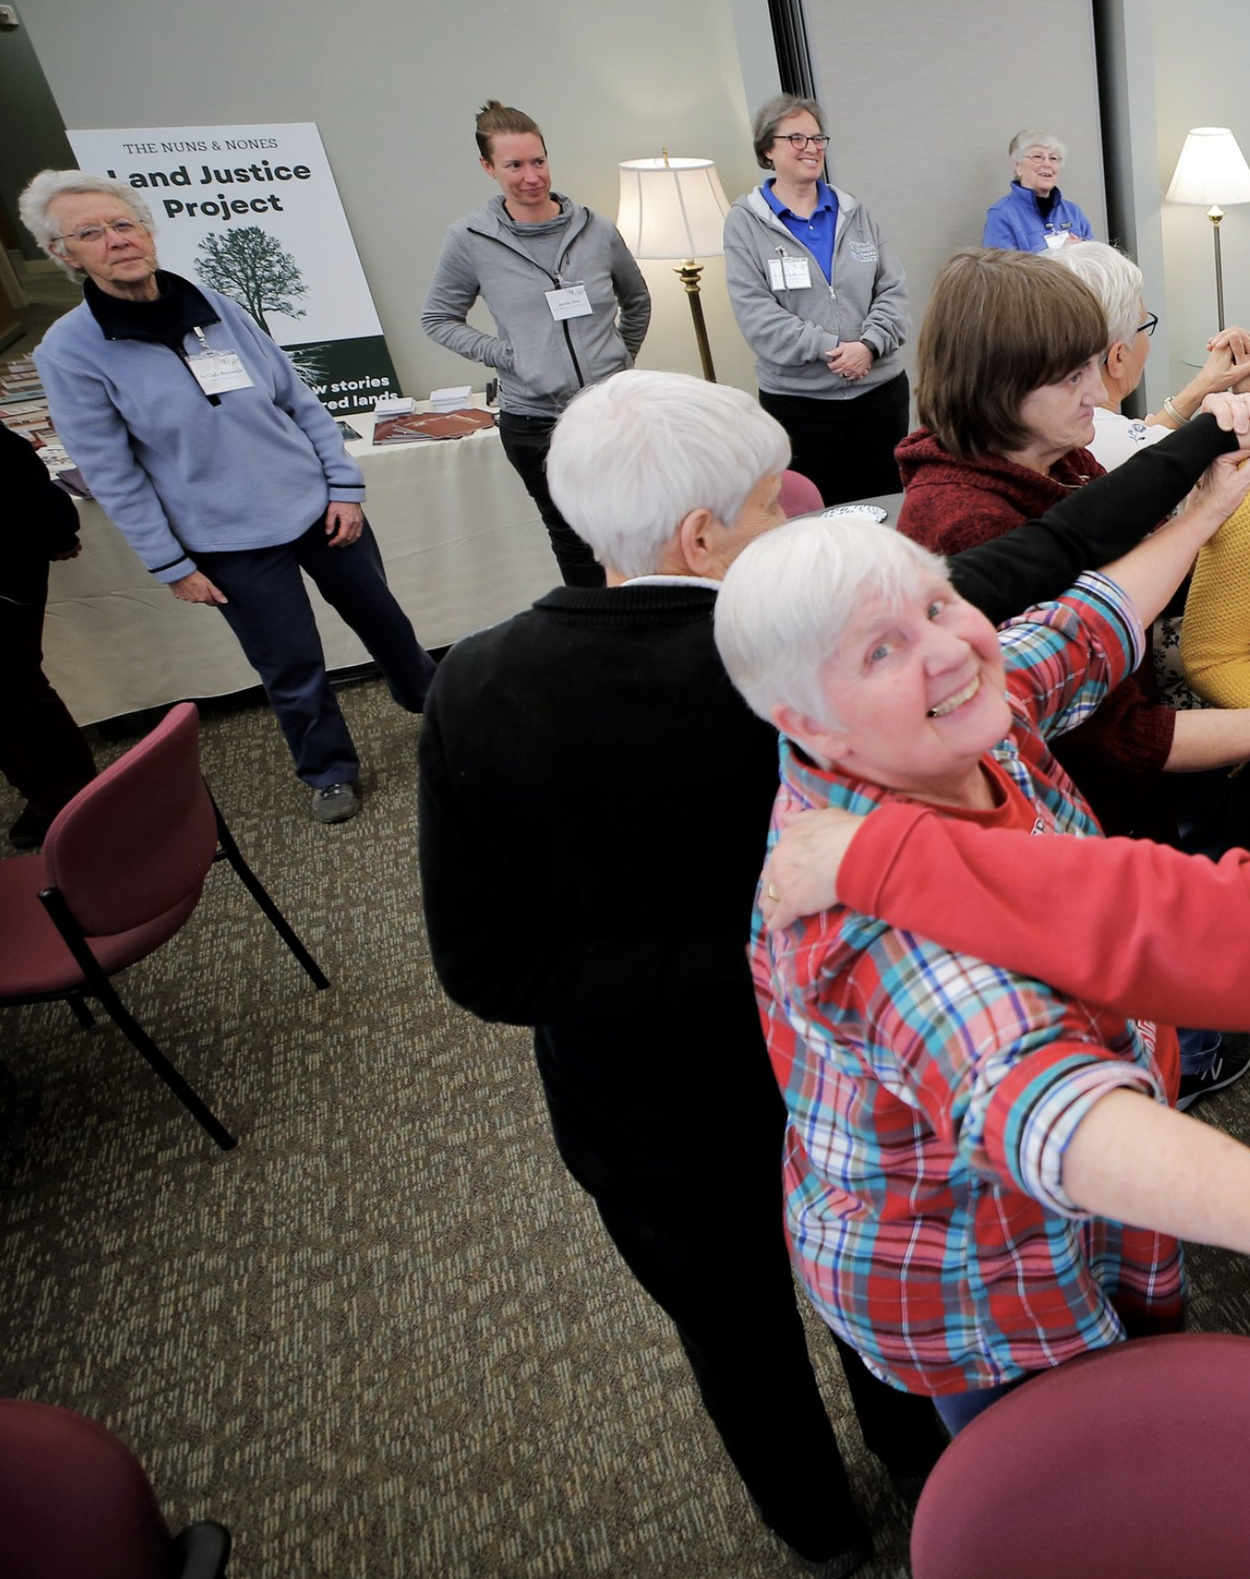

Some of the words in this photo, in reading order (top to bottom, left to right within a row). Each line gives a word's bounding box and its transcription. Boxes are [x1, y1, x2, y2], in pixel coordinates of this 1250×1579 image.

[123, 143, 158, 155] THE
[161, 141, 208, 153] NUNS
[212, 140, 221, 151] &
[225, 138, 279, 150] NONES
[200, 160, 311, 185] Justice
[163, 193, 284, 221] Project
[331, 376, 390, 392] stories
[353, 391, 398, 406] lands
